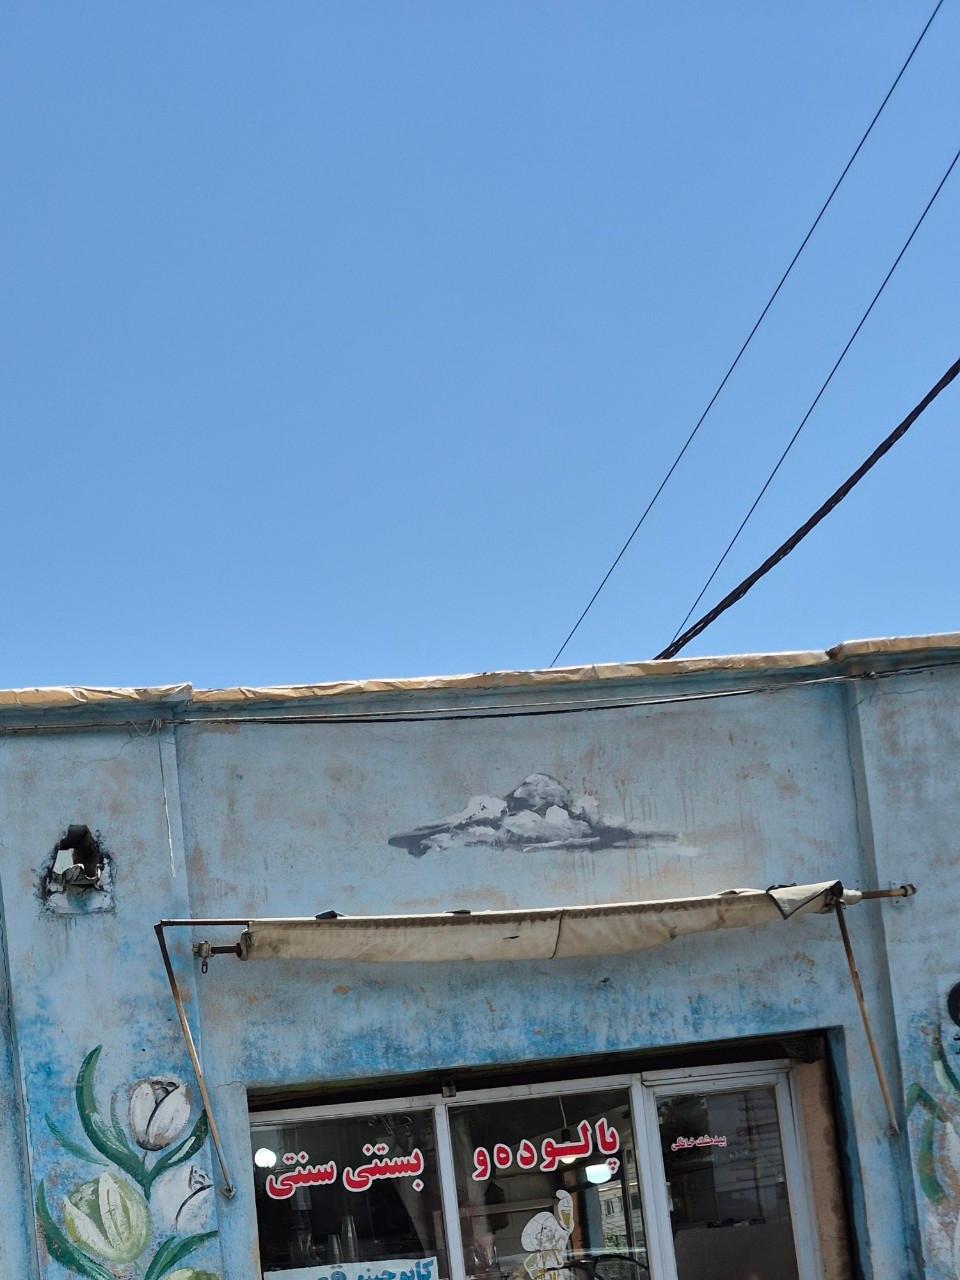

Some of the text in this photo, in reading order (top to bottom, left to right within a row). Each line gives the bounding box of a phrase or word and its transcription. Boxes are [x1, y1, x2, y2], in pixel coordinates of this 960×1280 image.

[266, 1143, 425, 1200] بستنی سنتی
[472, 1146, 490, 1181] و
